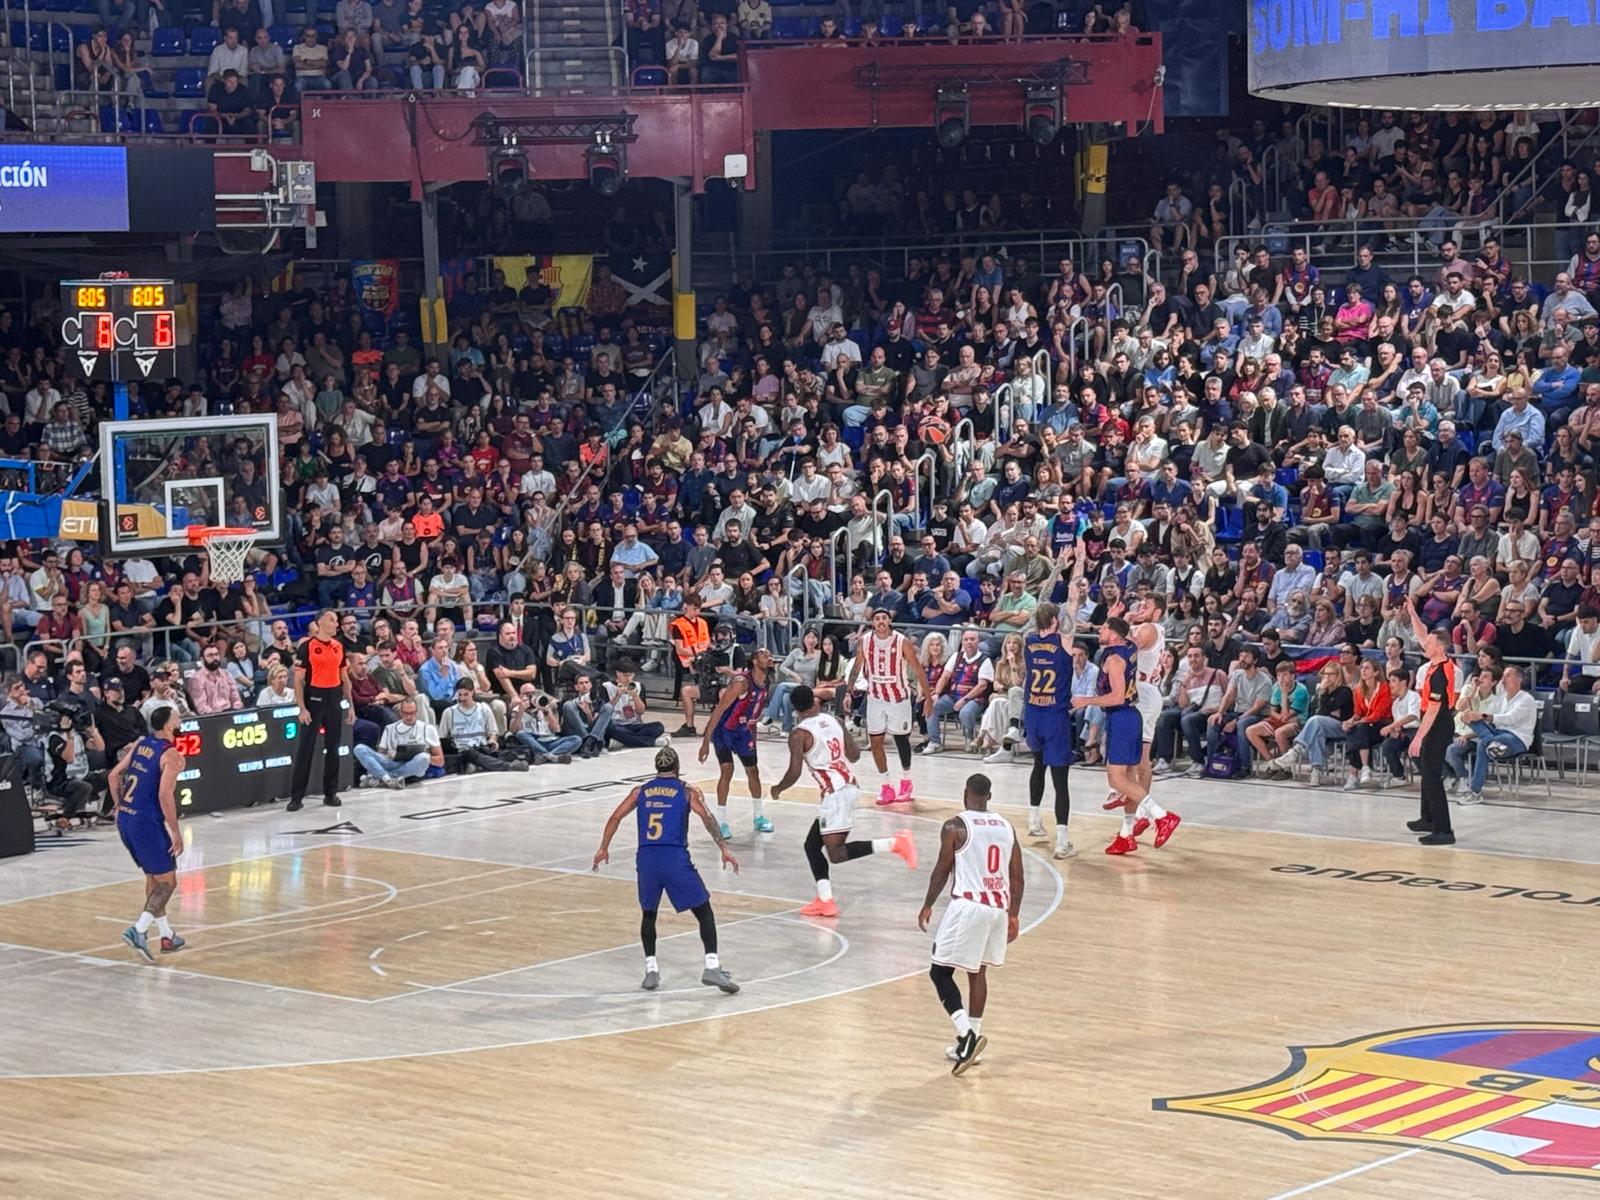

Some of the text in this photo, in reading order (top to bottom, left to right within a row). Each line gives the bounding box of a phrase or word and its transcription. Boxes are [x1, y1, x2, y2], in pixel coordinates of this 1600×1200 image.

[0, 160, 47, 188] CIÓN
[156, 315, 171, 347] 6
[62, 516, 98, 534] ETI
[1031, 669, 1057, 693] 22
[223, 724, 267, 749] 6:05
[285, 723, 297, 739] 3
[176, 734, 201, 756] 52
[181, 788, 192, 806] 2
[646, 812, 664, 840] 5
[988, 844, 1000, 875] 0
